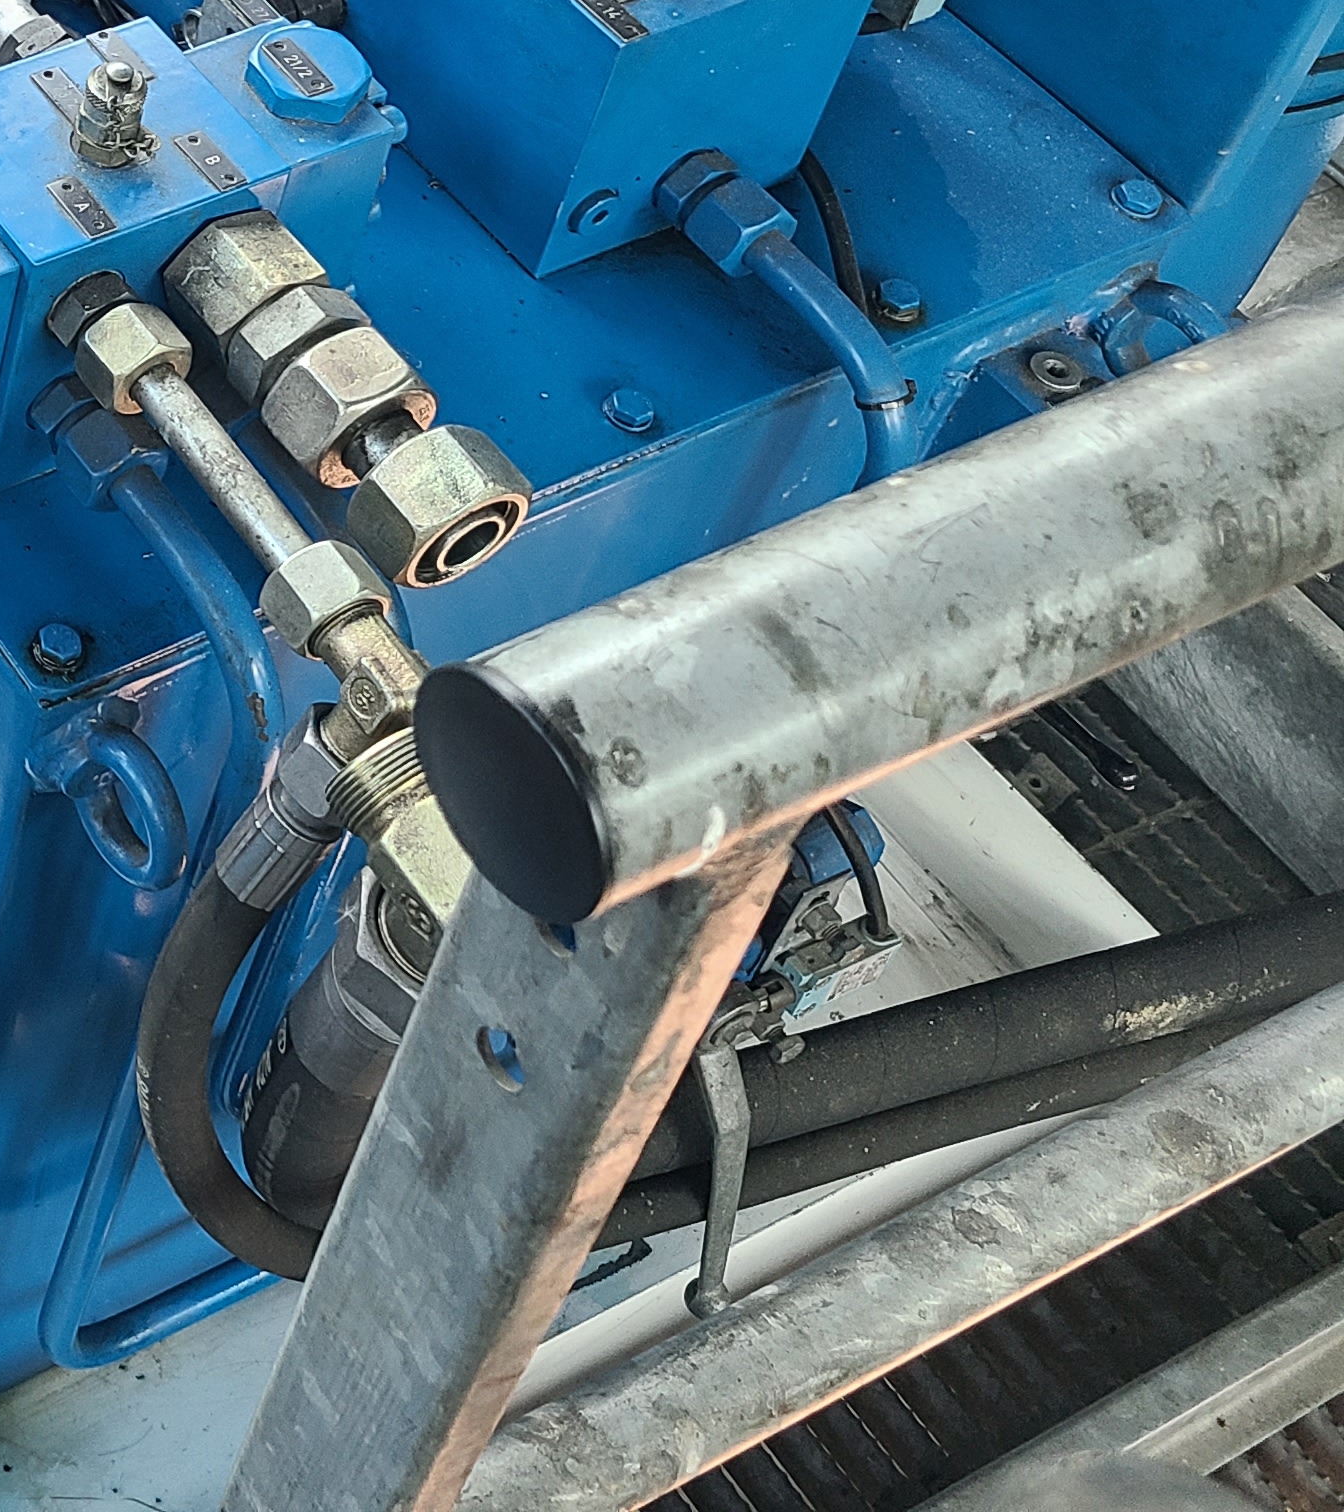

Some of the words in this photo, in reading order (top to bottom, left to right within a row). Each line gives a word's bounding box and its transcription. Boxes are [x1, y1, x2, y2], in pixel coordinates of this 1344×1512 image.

[284, 54, 313, 78] 21/2
[204, 154, 221, 165] B
[73, 201, 92, 214] A
